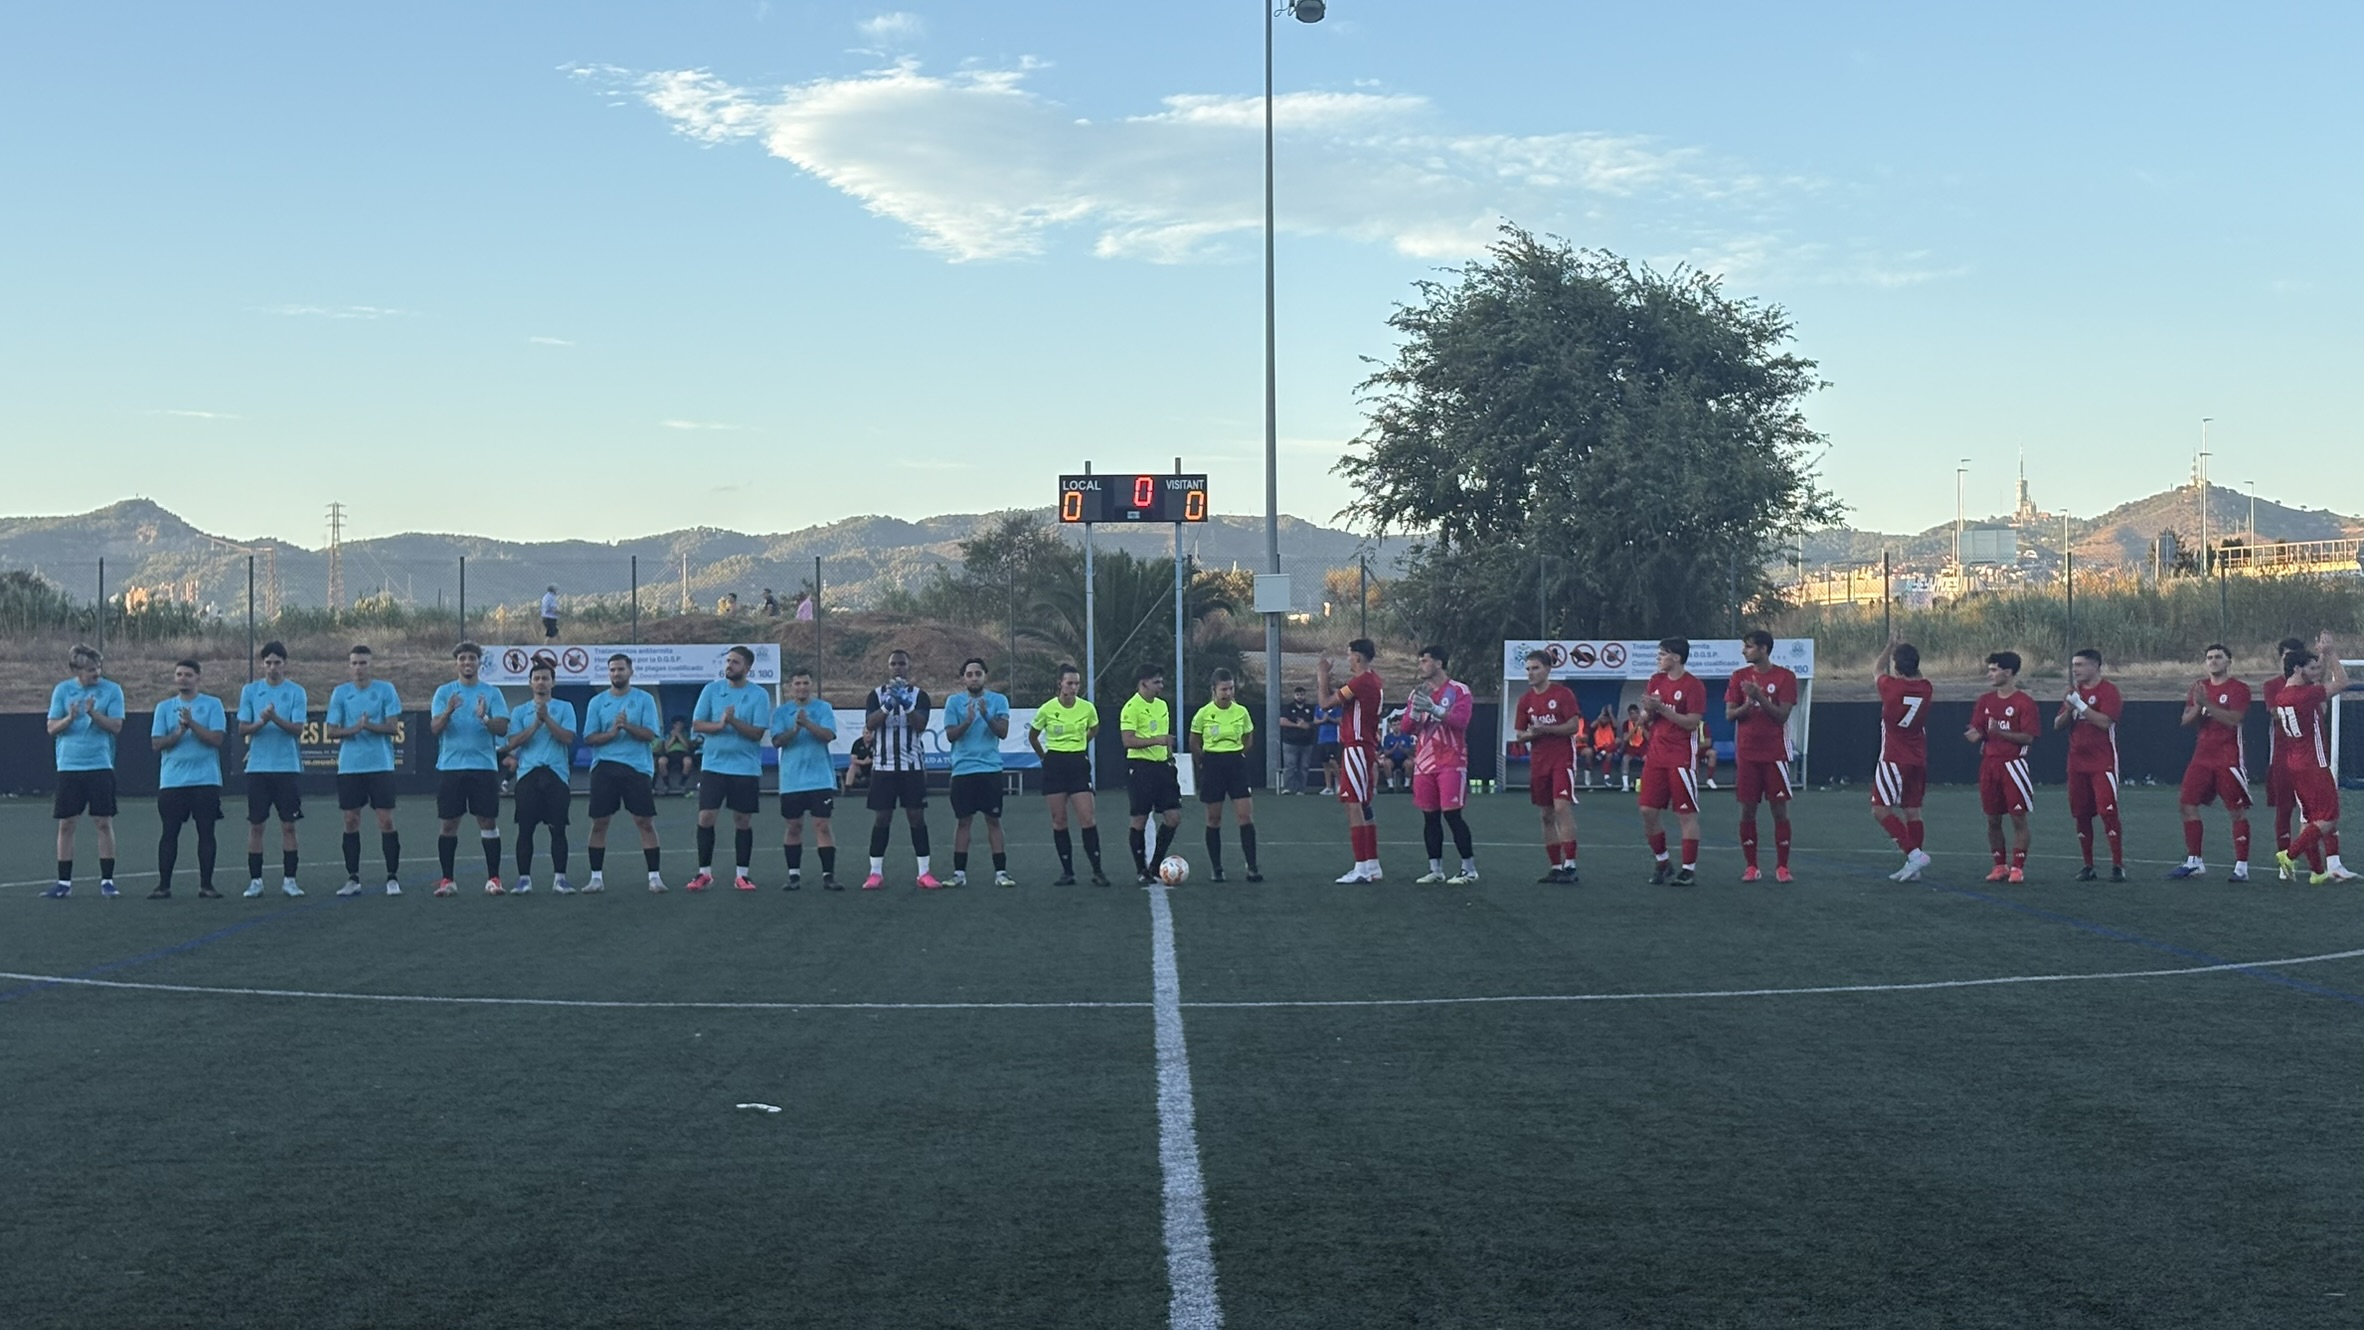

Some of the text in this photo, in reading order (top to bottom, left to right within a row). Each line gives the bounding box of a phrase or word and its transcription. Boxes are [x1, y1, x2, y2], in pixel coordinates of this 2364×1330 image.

[1062, 480, 1102, 491] LOCAL
[1133, 476, 1154, 508] 0
[1165, 479, 1205, 490] VISITANT
[1062, 491, 1083, 521] 0
[1184, 490, 1205, 520] 0
[758, 669, 774, 678] 180
[1794, 664, 1809, 673] 180
[1897, 695, 1924, 728] 7
